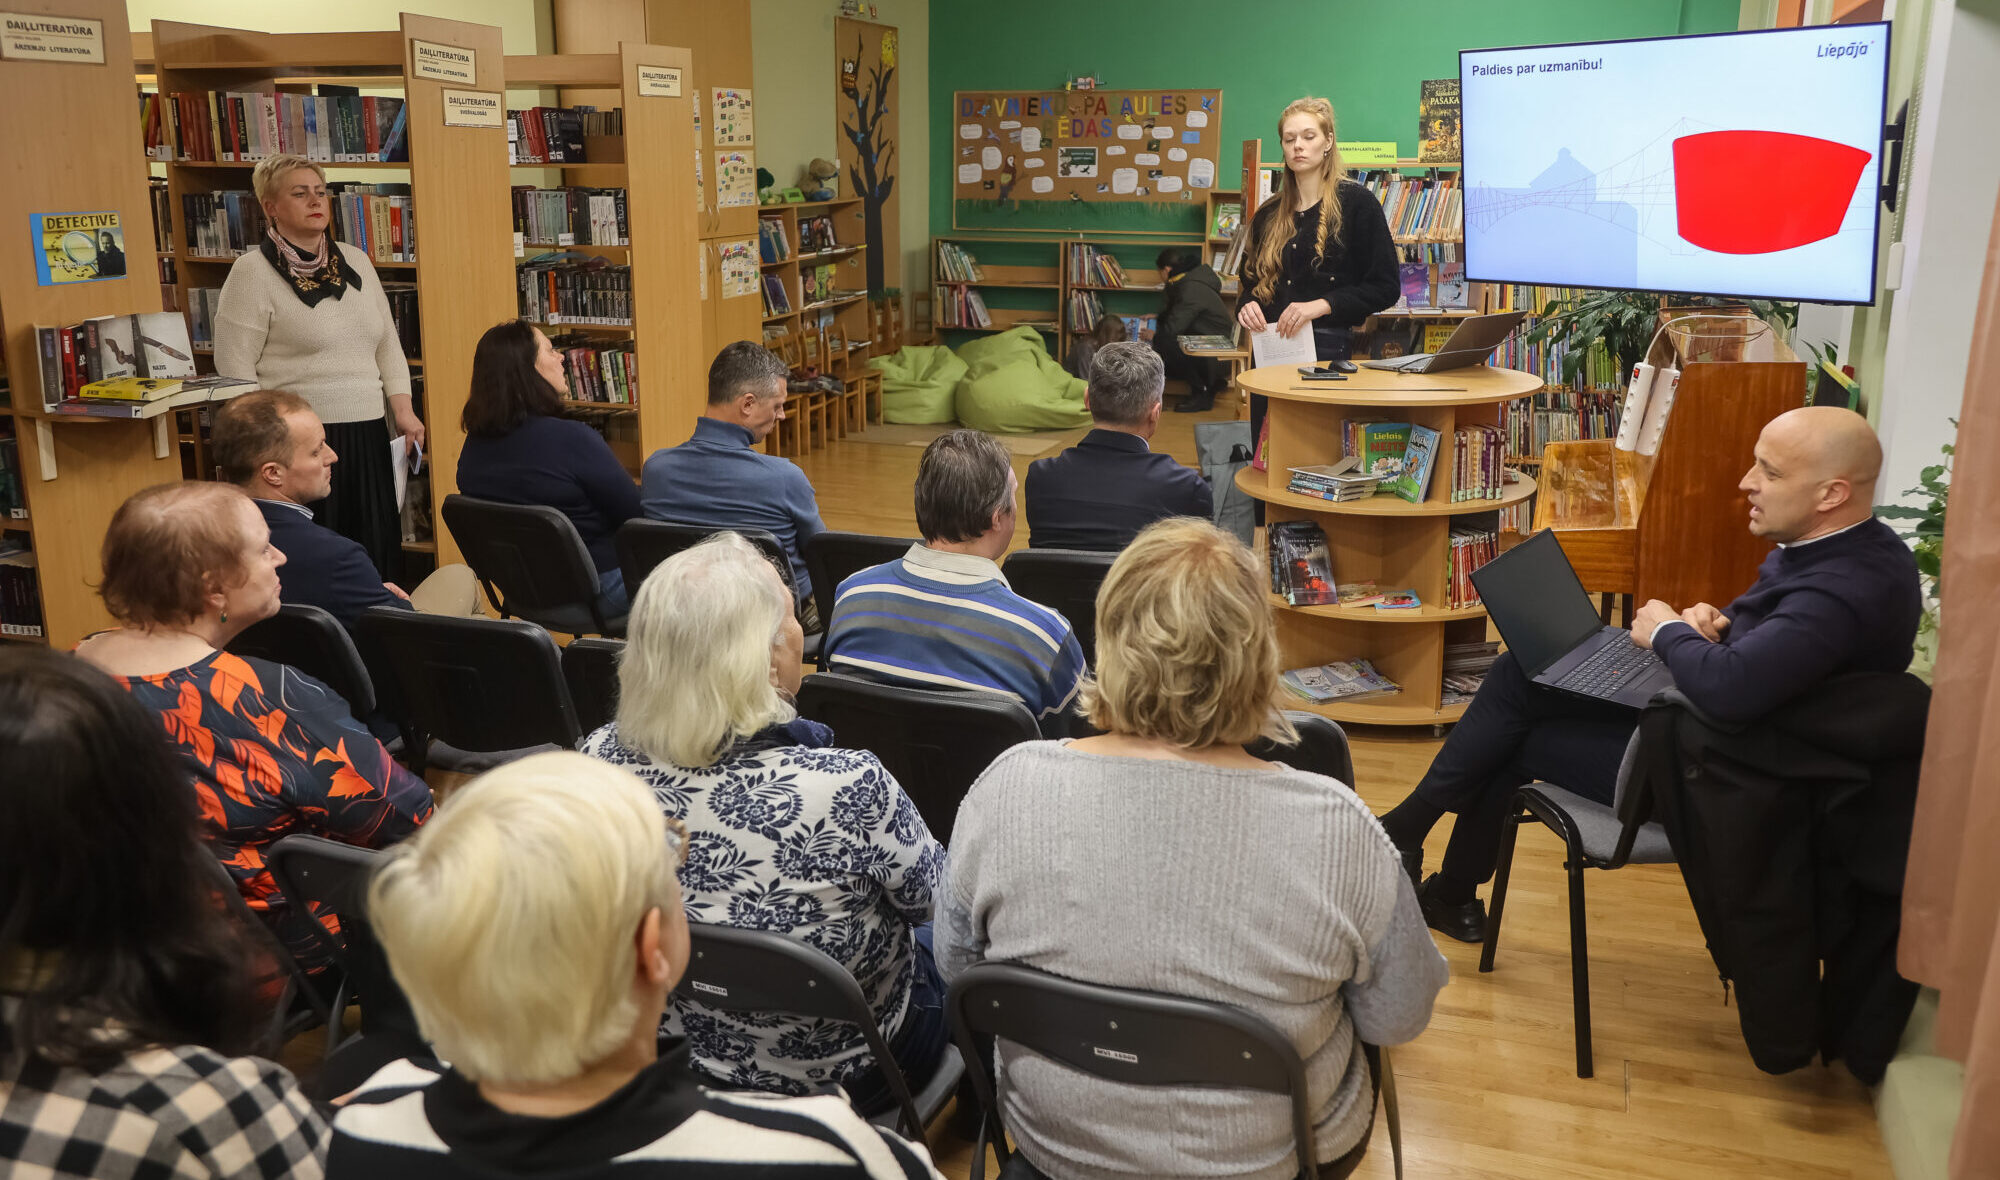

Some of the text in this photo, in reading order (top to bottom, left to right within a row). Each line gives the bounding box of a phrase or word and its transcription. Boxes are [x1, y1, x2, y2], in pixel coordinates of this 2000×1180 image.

[6, 20, 93, 36] DAIĻLITERATŪRA
[49, 46, 91, 55] LITERATŪRA
[419, 47, 470, 62] DAIĻLITERATŪRA
[1817, 41, 1868, 59] Liepāja
[443, 69, 468, 78] LITERATŪRA
[1472, 58, 1603, 76] Paldies par uzmanību!
[448, 96, 497, 107] DAIĻLITERATŪRA
[1084, 95, 1187, 116] PASAULES
[1042, 115, 1112, 139] PĒDAS
[46, 214, 117, 230] DETECTIVE
[1373, 432, 1402, 440] Lielais
[1370, 441, 1406, 452] NEITS
